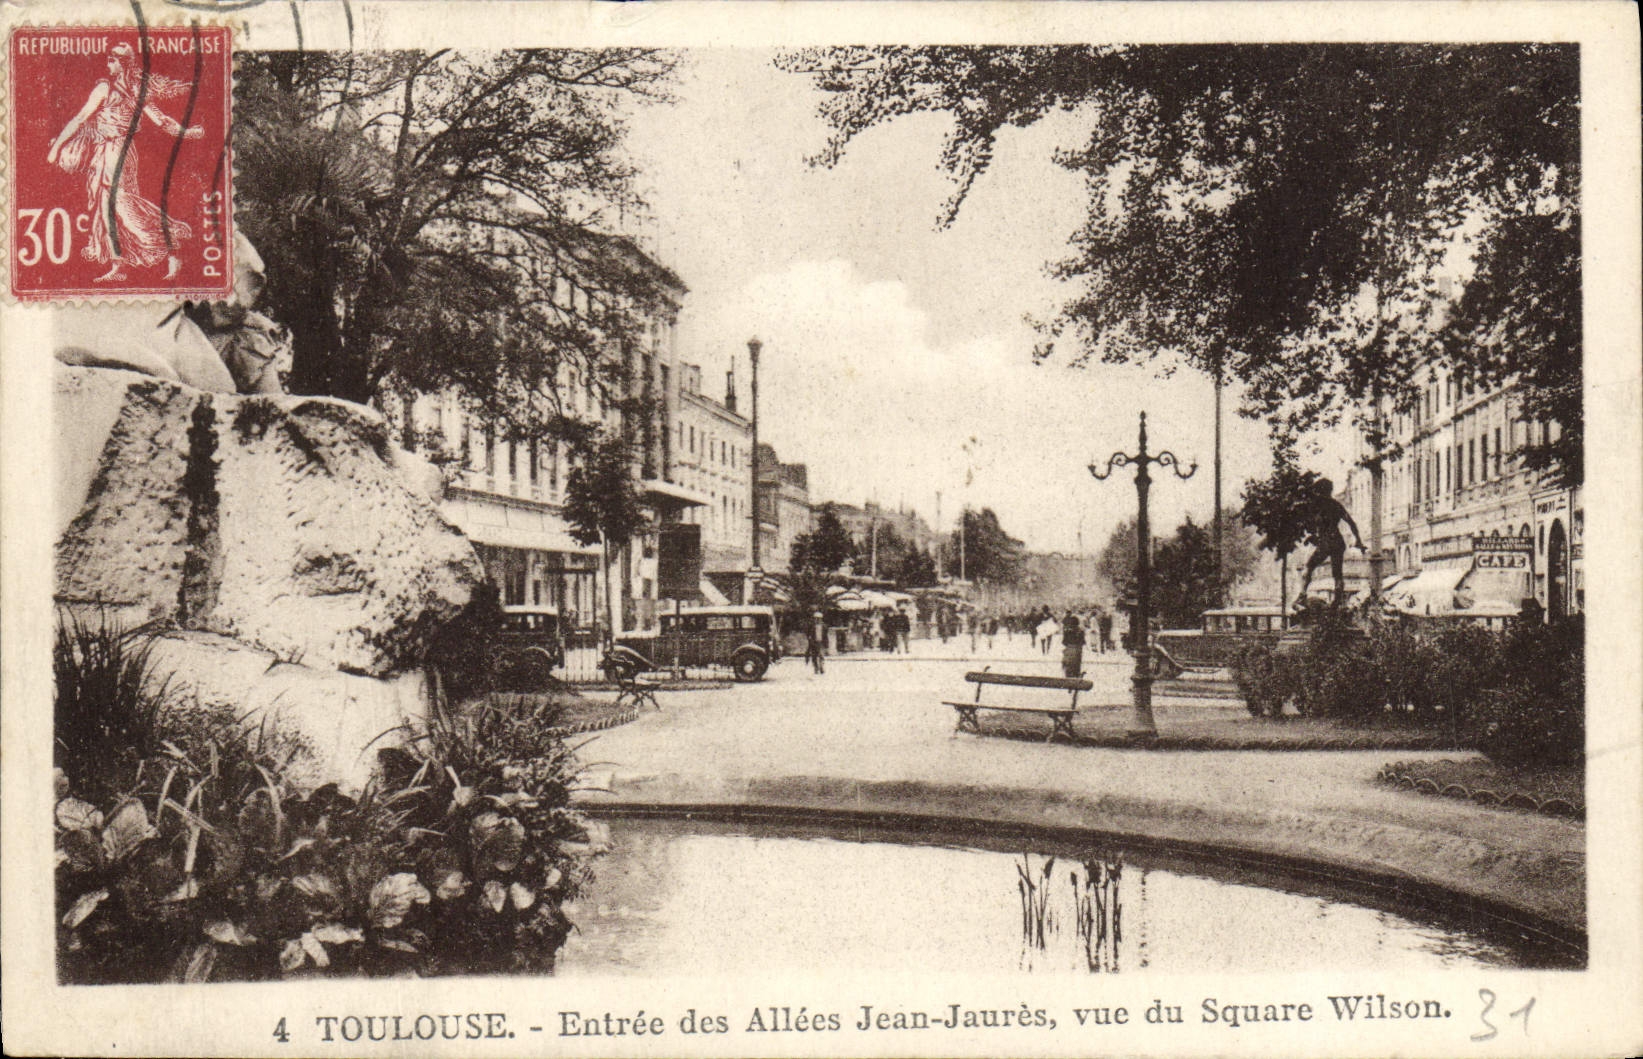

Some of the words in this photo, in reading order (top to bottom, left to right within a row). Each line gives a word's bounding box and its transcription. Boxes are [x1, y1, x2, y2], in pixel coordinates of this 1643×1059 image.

[138, 36, 221, 56] FRANÇAISE
[203, 190, 222, 277] POSTES
[1470, 988, 1537, 1042] 31
